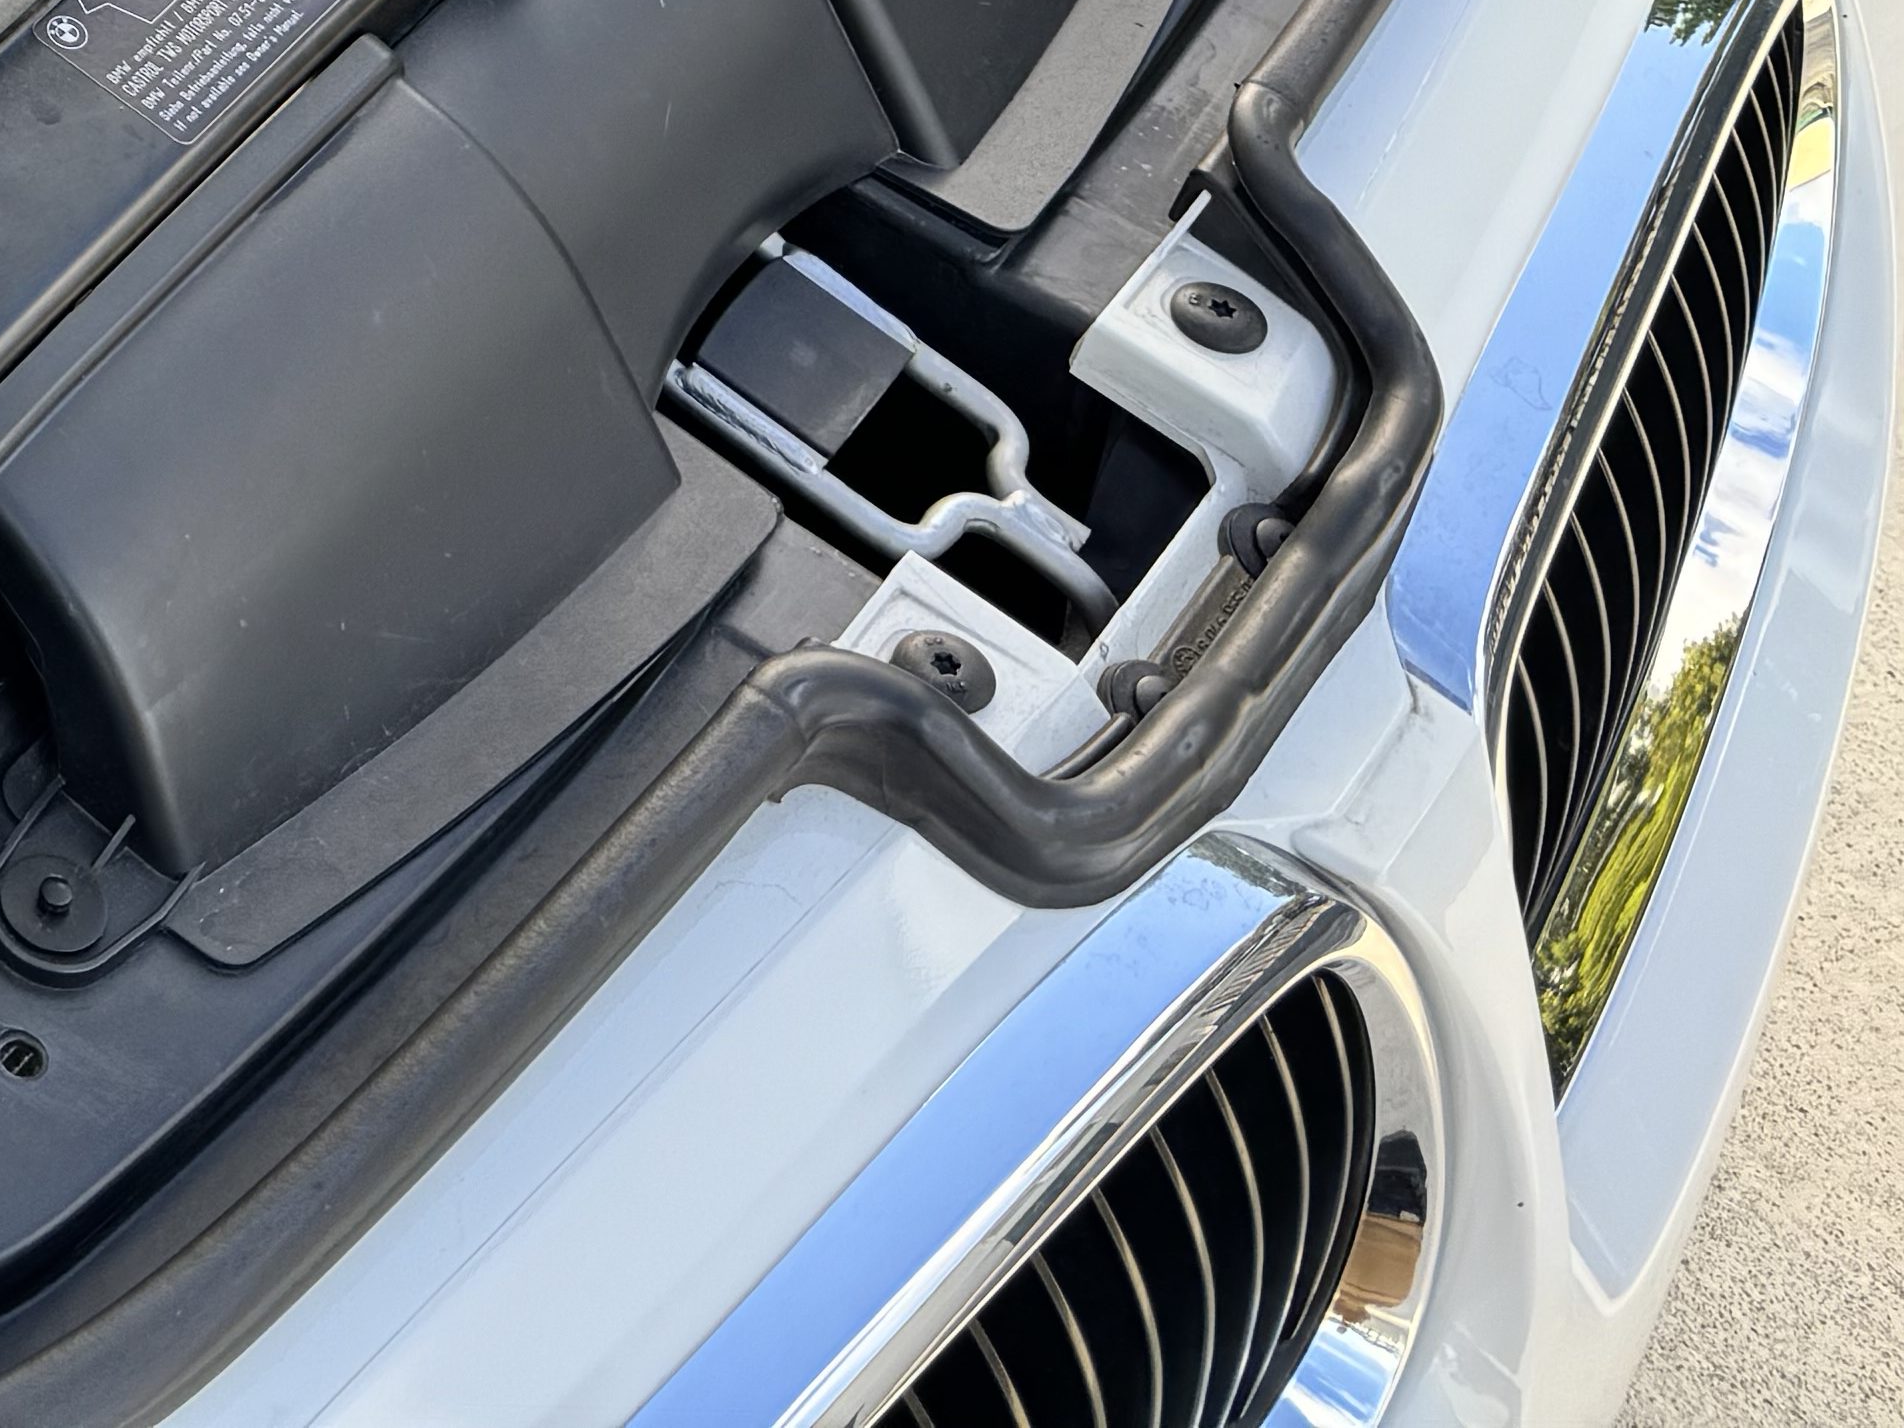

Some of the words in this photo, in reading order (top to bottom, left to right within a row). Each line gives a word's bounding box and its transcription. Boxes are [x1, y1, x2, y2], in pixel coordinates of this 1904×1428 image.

[105, 60, 131, 84] BMW
[133, 19, 176, 61] empfiehlt
[121, 60, 163, 96] CASTROL
[156, 41, 182, 62] TWS
[140, 86, 165, 109] BMW
